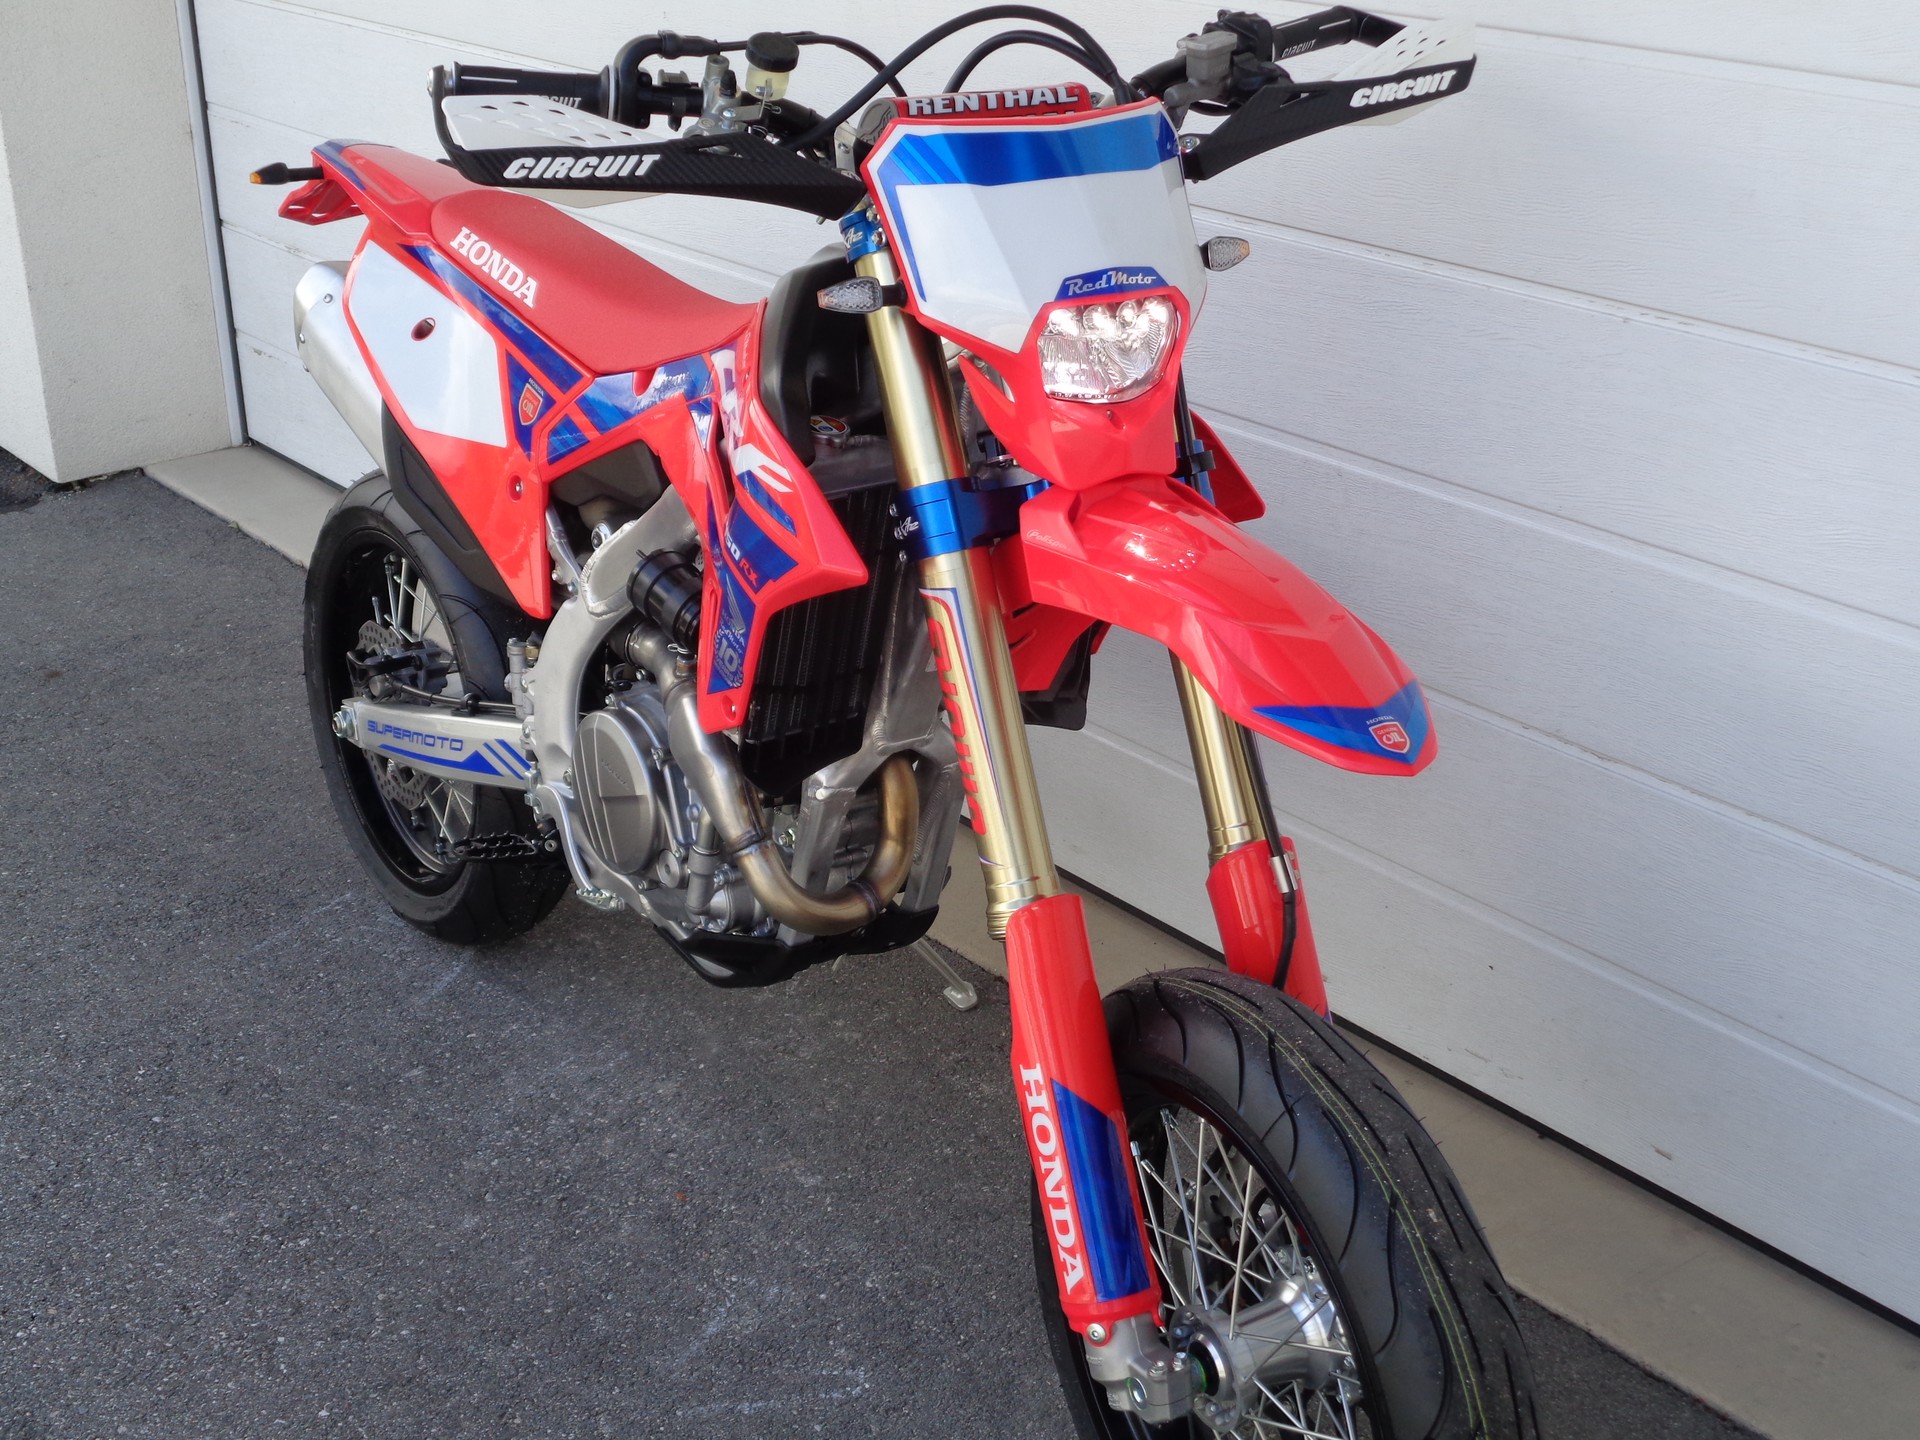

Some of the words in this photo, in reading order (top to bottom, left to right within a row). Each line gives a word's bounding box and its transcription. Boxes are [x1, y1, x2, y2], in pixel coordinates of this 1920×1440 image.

[1281, 39, 1316, 58] CIRCUIT
[907, 86, 1078, 116] RENTHAL
[1349, 69, 1457, 108] CIRCUIT
[502, 153, 661, 180] CIRCUIT
[449, 226, 537, 308] HONDA
[739, 558, 759, 588] RX
[718, 637, 739, 673] 10
[1365, 714, 1395, 725] HONDA
[367, 719, 464, 752] SUPERMOTO
[1382, 732, 1406, 745] OIL
[1019, 1062, 1086, 1296] HONDA
